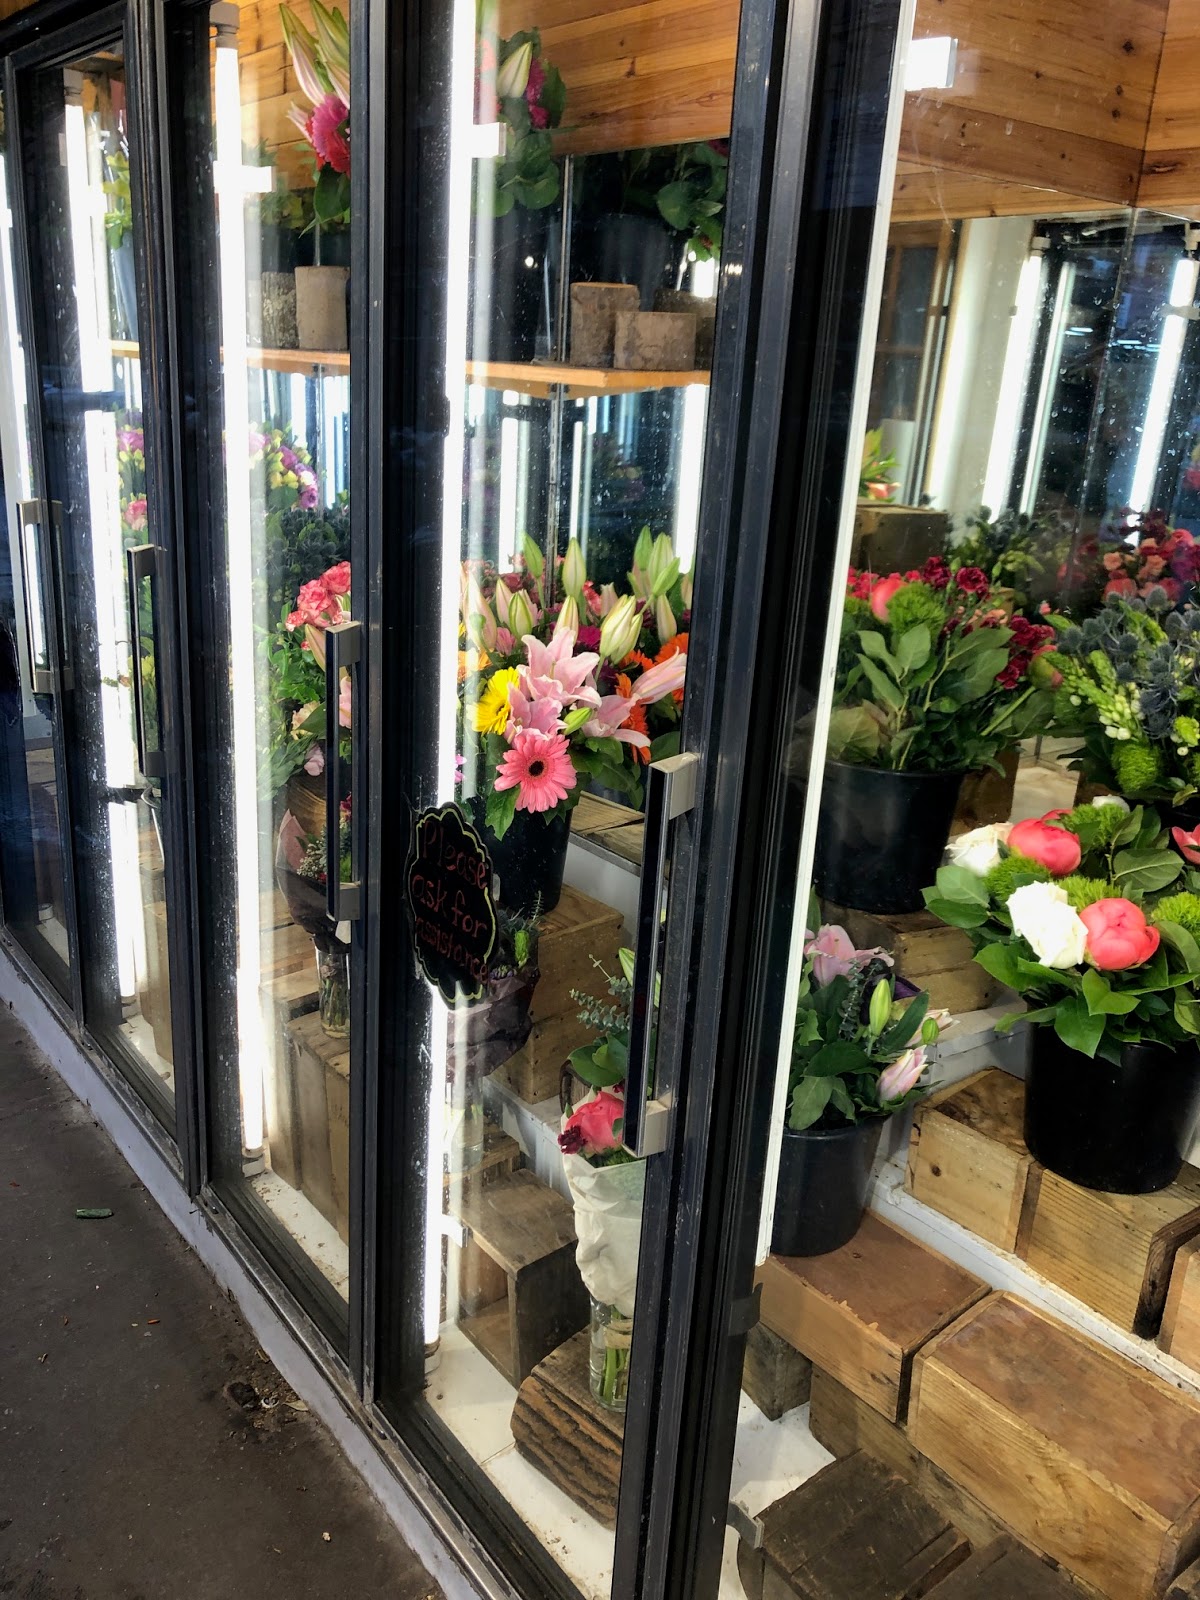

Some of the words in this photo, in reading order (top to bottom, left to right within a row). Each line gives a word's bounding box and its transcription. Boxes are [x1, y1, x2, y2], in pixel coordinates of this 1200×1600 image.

[423, 820, 486, 889] Please
[412, 874, 447, 915] ask
[452, 889, 488, 938] for
[415, 915, 488, 983] assistance
